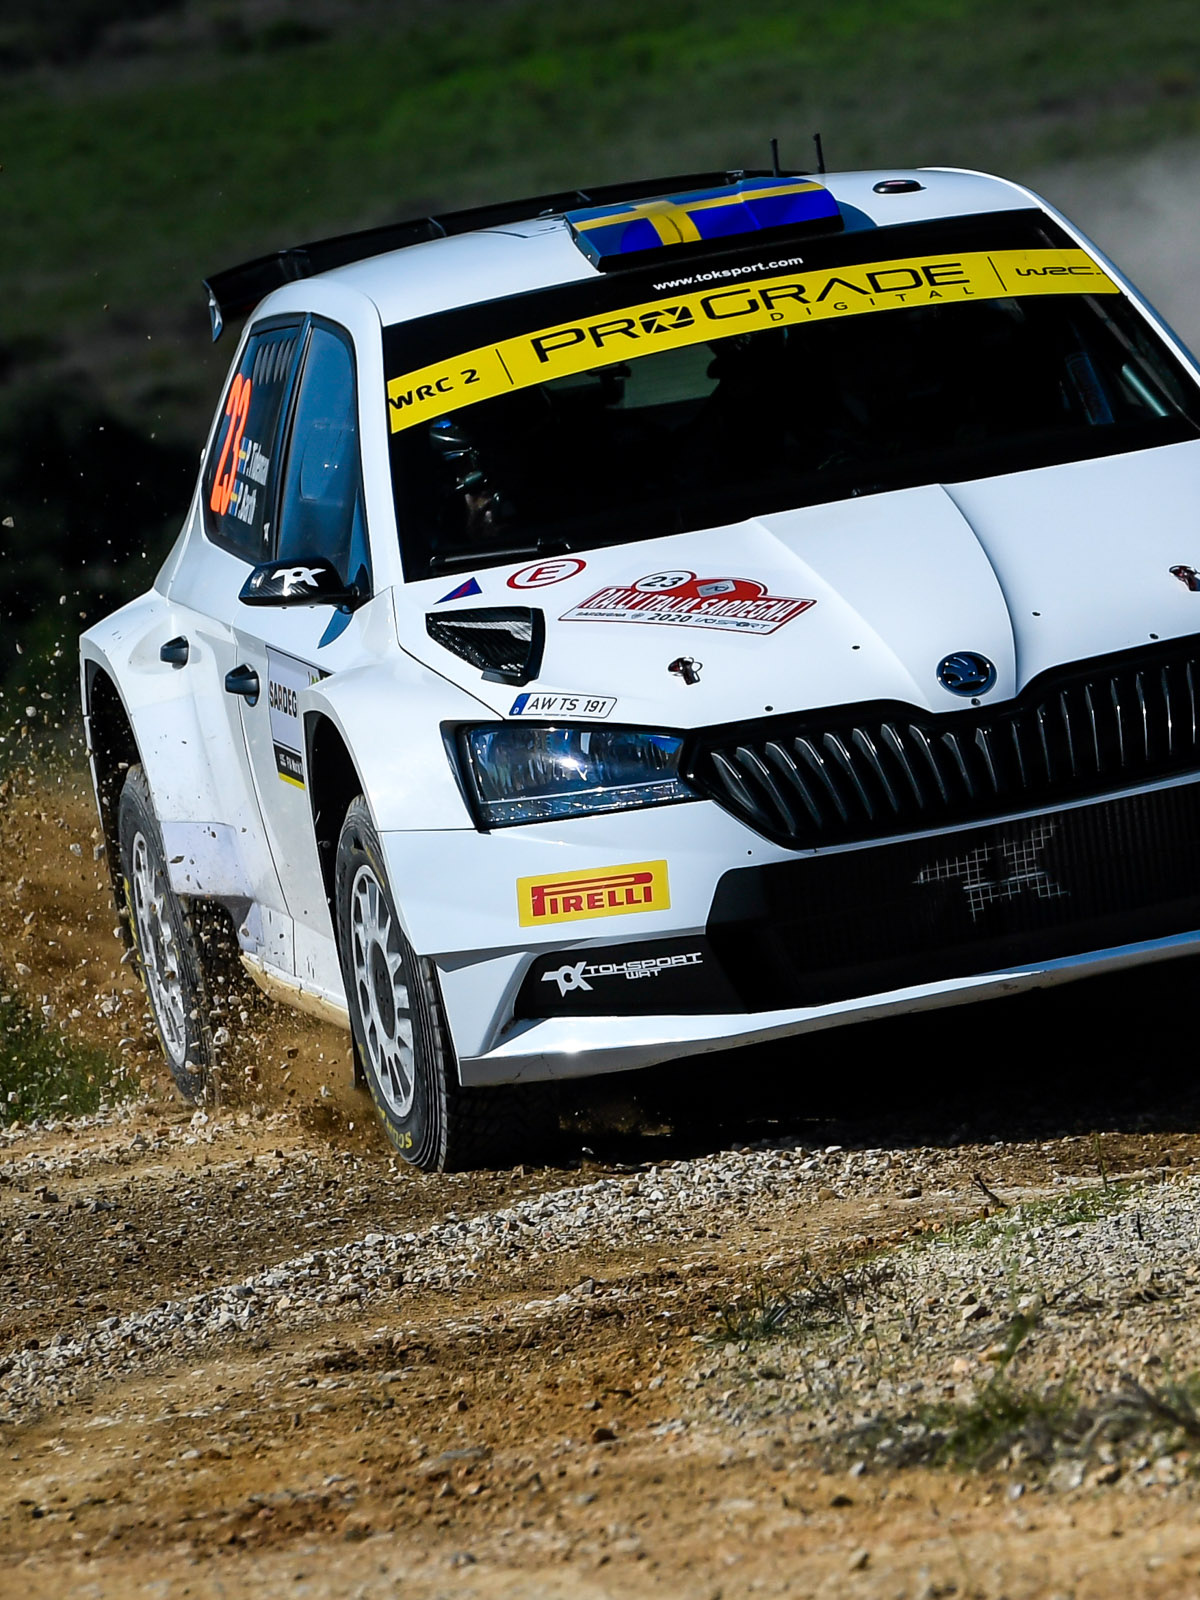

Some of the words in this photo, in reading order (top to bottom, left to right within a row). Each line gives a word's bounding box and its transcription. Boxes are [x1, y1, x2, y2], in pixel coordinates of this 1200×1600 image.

[652, 256, 804, 291] www.toksport.com
[530, 262, 970, 364] PROGRADE
[769, 286, 975, 322] DIGITAL
[388, 376, 454, 411] WRC
[460, 368, 481, 385] 2
[209, 372, 252, 517] 23
[526, 563, 567, 583] E
[640, 575, 685, 589] 23
[583, 588, 652, 609] RALLY
[635, 593, 702, 614] ITALIA
[690, 598, 802, 622] SARDEGNA
[647, 612, 693, 623] 2020
[527, 697, 558, 710] AW
[559, 697, 580, 711] TS
[583, 699, 607, 713] 191
[531, 871, 654, 918] PIRELLI
[584, 951, 703, 976] TOKSPORT
[625, 968, 662, 980] WRT
